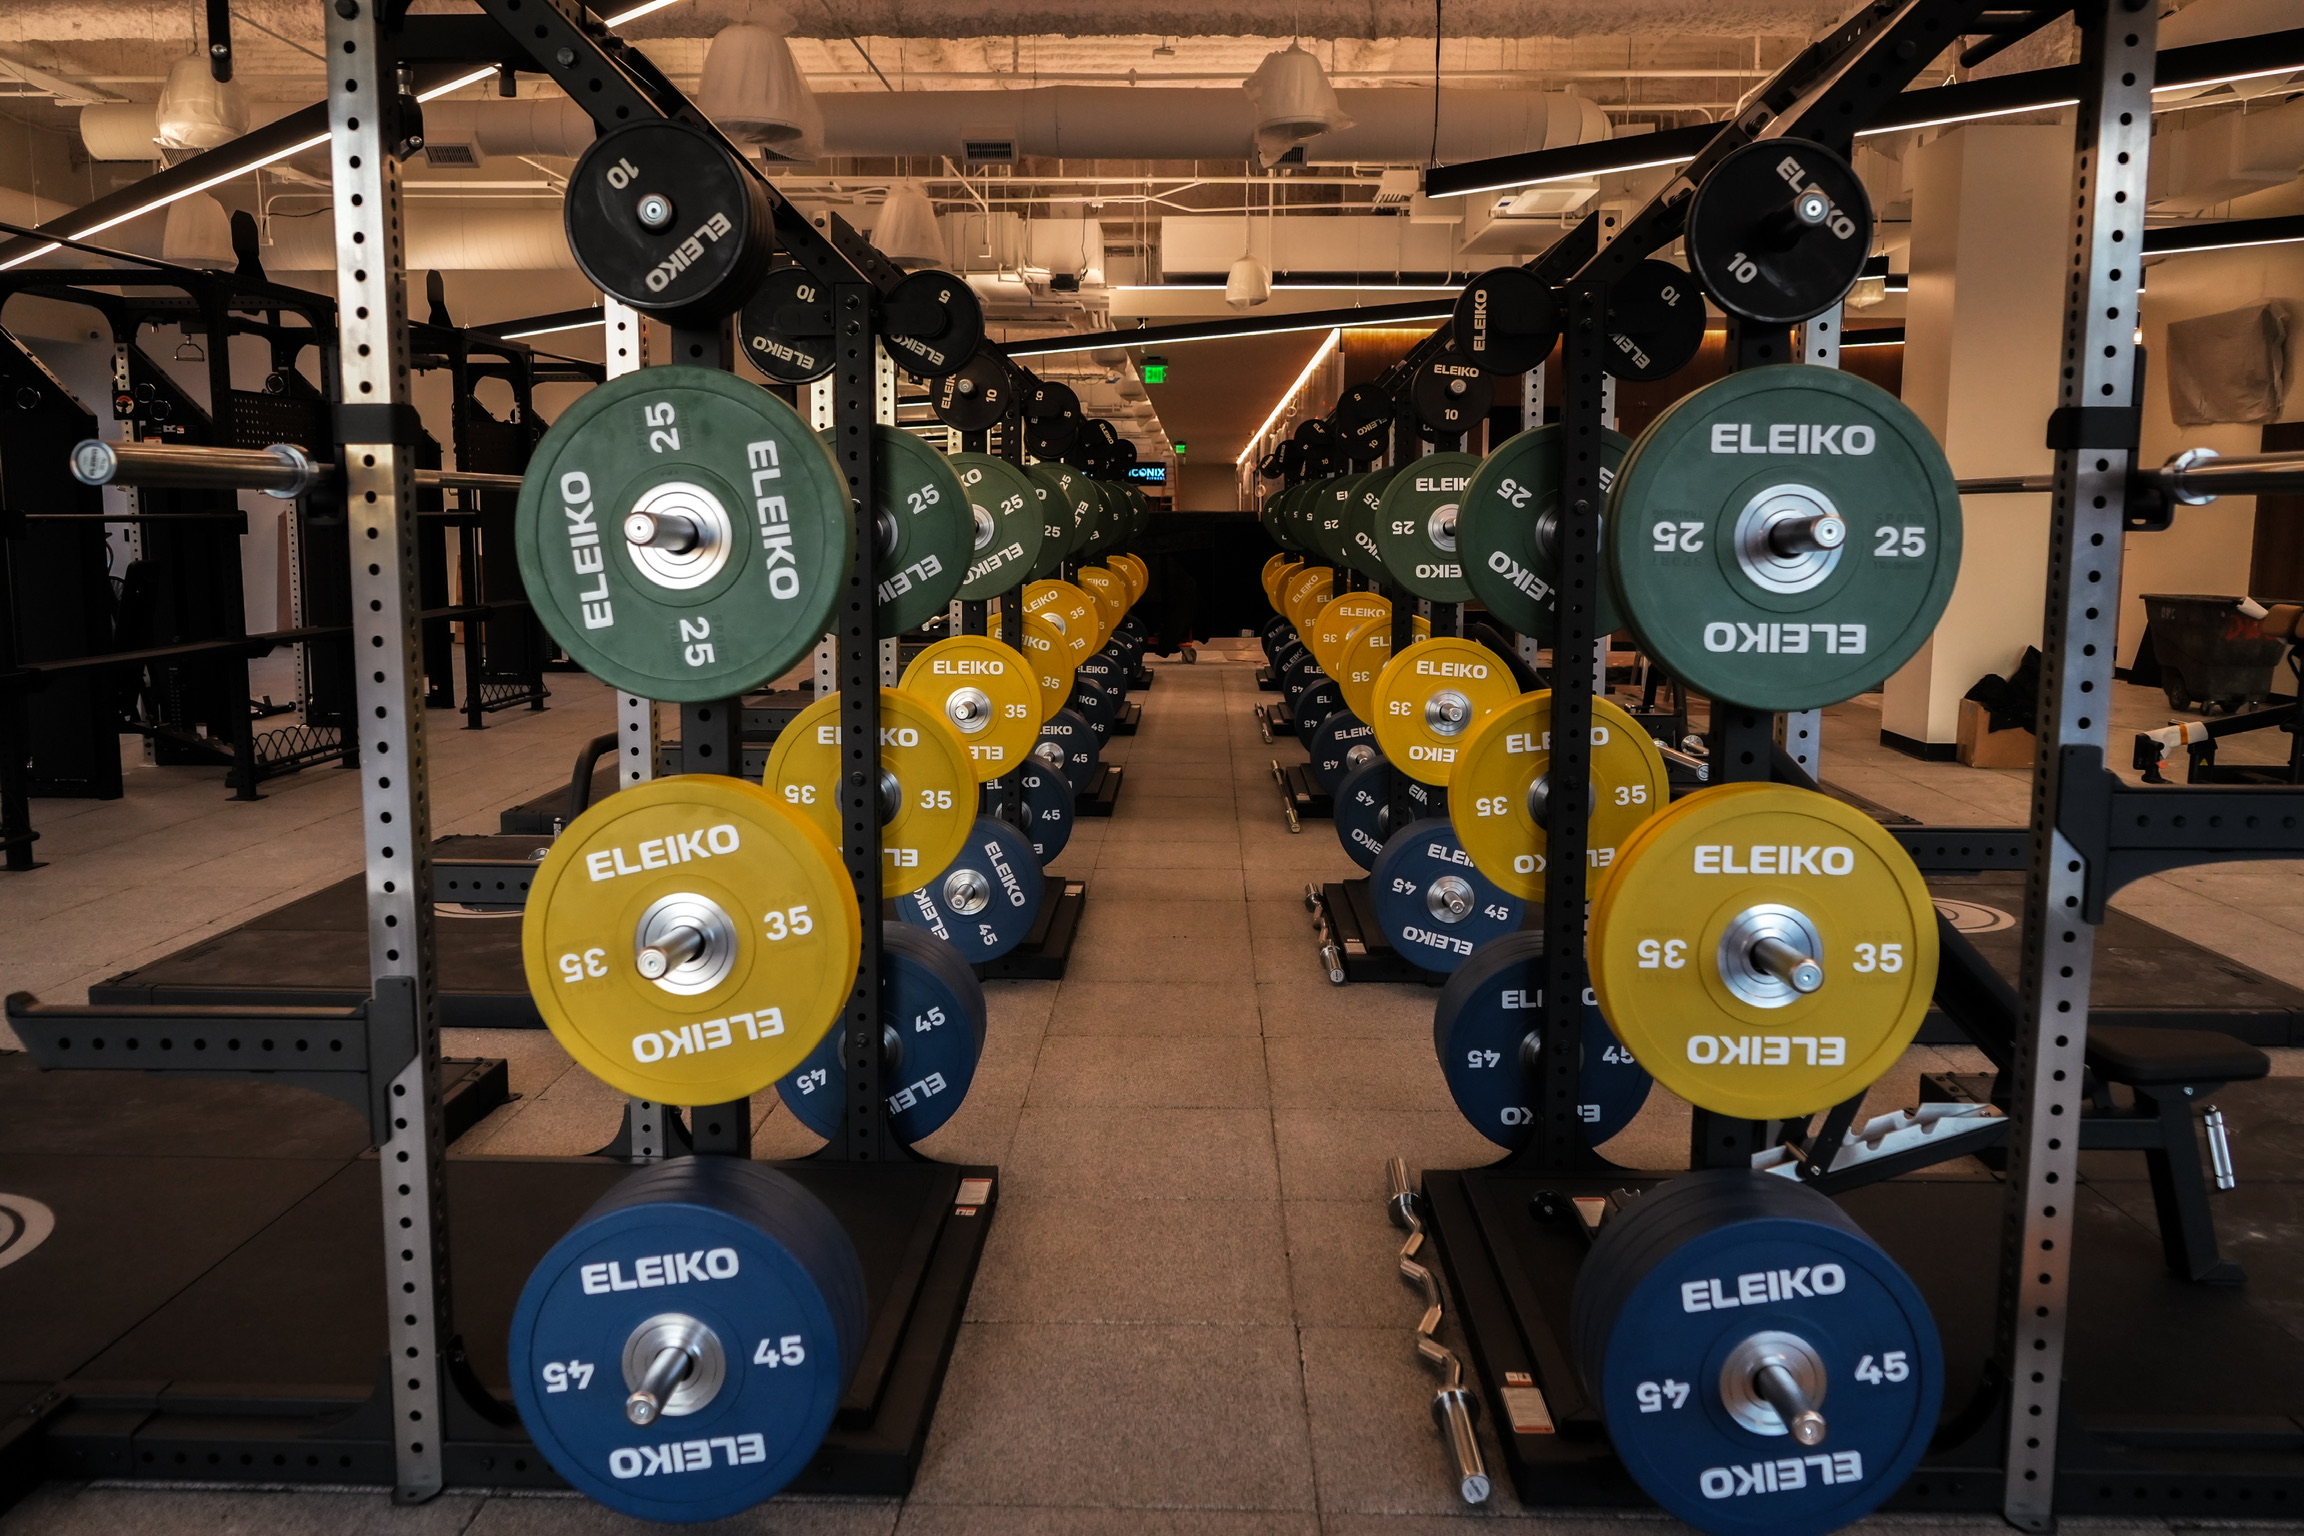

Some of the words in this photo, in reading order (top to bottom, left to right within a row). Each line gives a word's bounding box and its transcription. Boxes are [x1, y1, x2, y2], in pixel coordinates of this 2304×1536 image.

[606, 157, 640, 190] 10
[645, 211, 732, 293] ELEIKO
[1726, 252, 1758, 284] 10
[796, 284, 816, 303] 10
[938, 289, 952, 304] 5
[1659, 285, 1681, 307] 10
[1473, 289, 1488, 351] ELEIKO
[751, 335, 815, 370] ELEIKO
[1433, 363, 1480, 378] ELEIKO
[986, 388, 998, 403] 10
[1444, 408, 1459, 421] 10
[644, 401, 681, 454] 25
[1368, 439, 1379, 449] 10
[1710, 423, 1876, 456] ELEIKO
[1060, 474, 1071, 491] 25
[1496, 478, 1533, 508] 25
[907, 483, 940, 514] 25
[1001, 494, 1024, 515] 25
[1363, 493, 1380, 511] 25
[747, 440, 800, 600] ELEIKO
[1323, 519, 1339, 530] 25
[1391, 520, 1415, 535] 25
[1652, 521, 1704, 553] 25
[1873, 526, 1926, 558] 25
[560, 470, 614, 630] ELEIKO
[1415, 564, 1462, 578] EIKO
[1292, 574, 1318, 603] ELEIKO
[1024, 590, 1058, 613] LEIKO
[1070, 606, 1085, 619] 35
[679, 616, 716, 667] 25
[1322, 633, 1337, 643] 35
[1703, 622, 1867, 655] ELEIKO
[933, 660, 1004, 675] ELEIKO
[1352, 671, 1370, 682] 35
[1416, 660, 1488, 680] ELEIKO
[1041, 676, 1060, 689] 35
[1106, 687, 1119, 695] 45
[1291, 685, 1303, 693] 45
[1004, 704, 1027, 719] 35
[1389, 701, 1412, 716] 35
[1039, 725, 1073, 735] EIKO
[1090, 723, 1105, 732] 45
[1304, 719, 1317, 728] 45
[1072, 753, 1088, 763] 45
[1323, 760, 1339, 770] 45
[785, 785, 816, 804] 35
[920, 790, 952, 810] 35
[1355, 790, 1375, 806] 45
[1614, 785, 1647, 805] 35
[1041, 810, 1061, 821] 45
[1476, 796, 1508, 817] 35
[585, 824, 740, 882] ELEIKO
[1693, 845, 1854, 876] ELEIKO
[984, 841, 1026, 907] ELEIKO
[1392, 878, 1417, 895] 45
[763, 905, 814, 941] 35
[1484, 904, 1509, 920] 45
[978, 923, 998, 946] 45
[1403, 926, 1473, 955] ELEIKO
[558, 948, 609, 983] 35
[1637, 939, 1687, 969] 35
[1852, 943, 1903, 973] 35
[915, 1006, 946, 1033] 45
[631, 1007, 786, 1064] ELEIKO
[1467, 1050, 1500, 1068] 45
[1687, 1035, 1846, 1066] ELEIKO
[796, 1068, 827, 1095] 45
[580, 1247, 739, 1295] ELEIKO
[1681, 1263, 1846, 1313] ELEIKO
[753, 1335, 805, 1368] 45
[542, 1360, 595, 1393] 45
[1854, 1351, 1910, 1385] 45
[1636, 1379, 1690, 1413] 45
[609, 1432, 766, 1479] ELEIKO
[1700, 1450, 1863, 1499] ELEIKO
